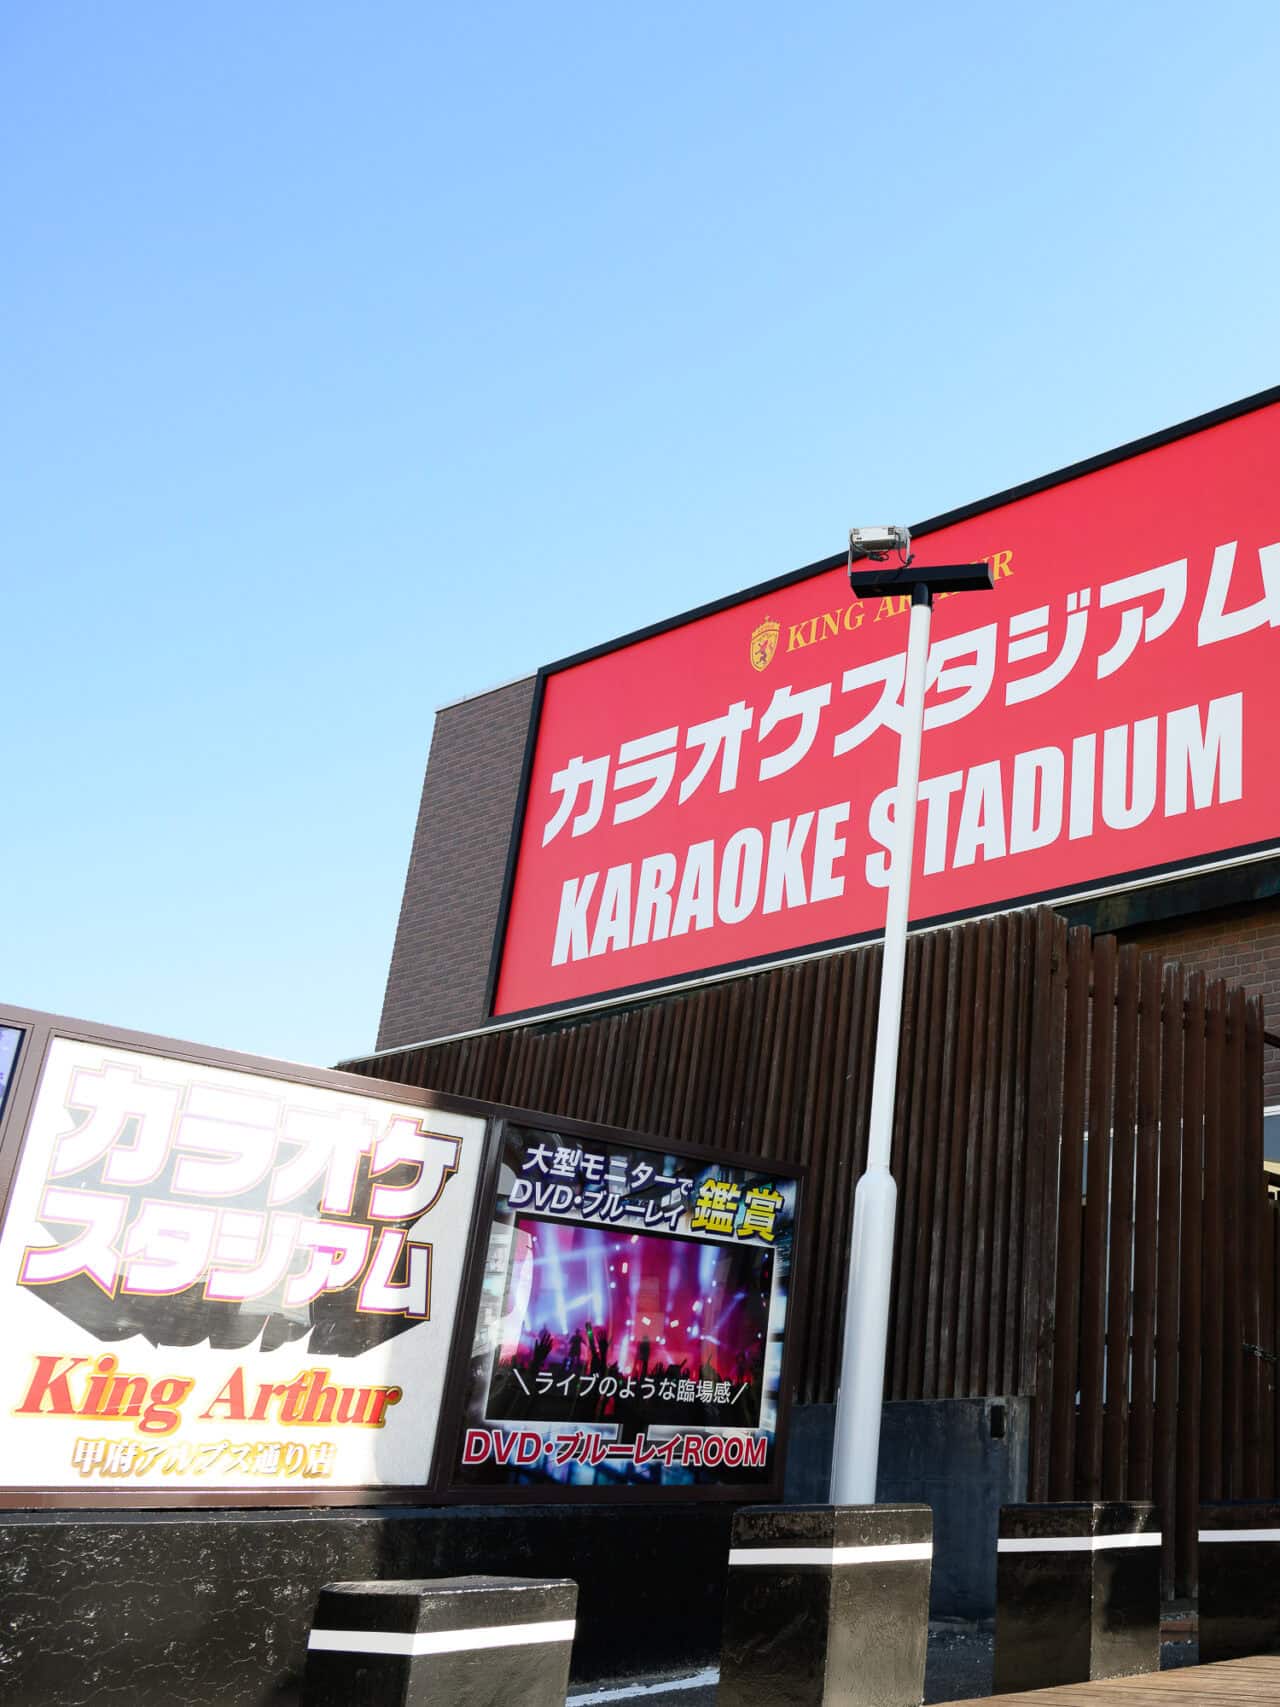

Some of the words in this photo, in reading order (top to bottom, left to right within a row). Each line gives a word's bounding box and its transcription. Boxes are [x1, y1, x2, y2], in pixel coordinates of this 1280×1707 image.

[786, 601, 865, 653] KING
[551, 801, 852, 967] KARAOKE
[865, 691, 1243, 888] STADIUM
[47, 1060, 463, 1221] カラオケ
[521, 1143, 694, 1196] 大型モニターで
[690, 1179, 784, 1241] 鑑賞
[14, 1354, 194, 1434] King
[198, 1366, 402, 1428] Arthur
[72, 1439, 337, 1478] 甲府アルプス通り店
